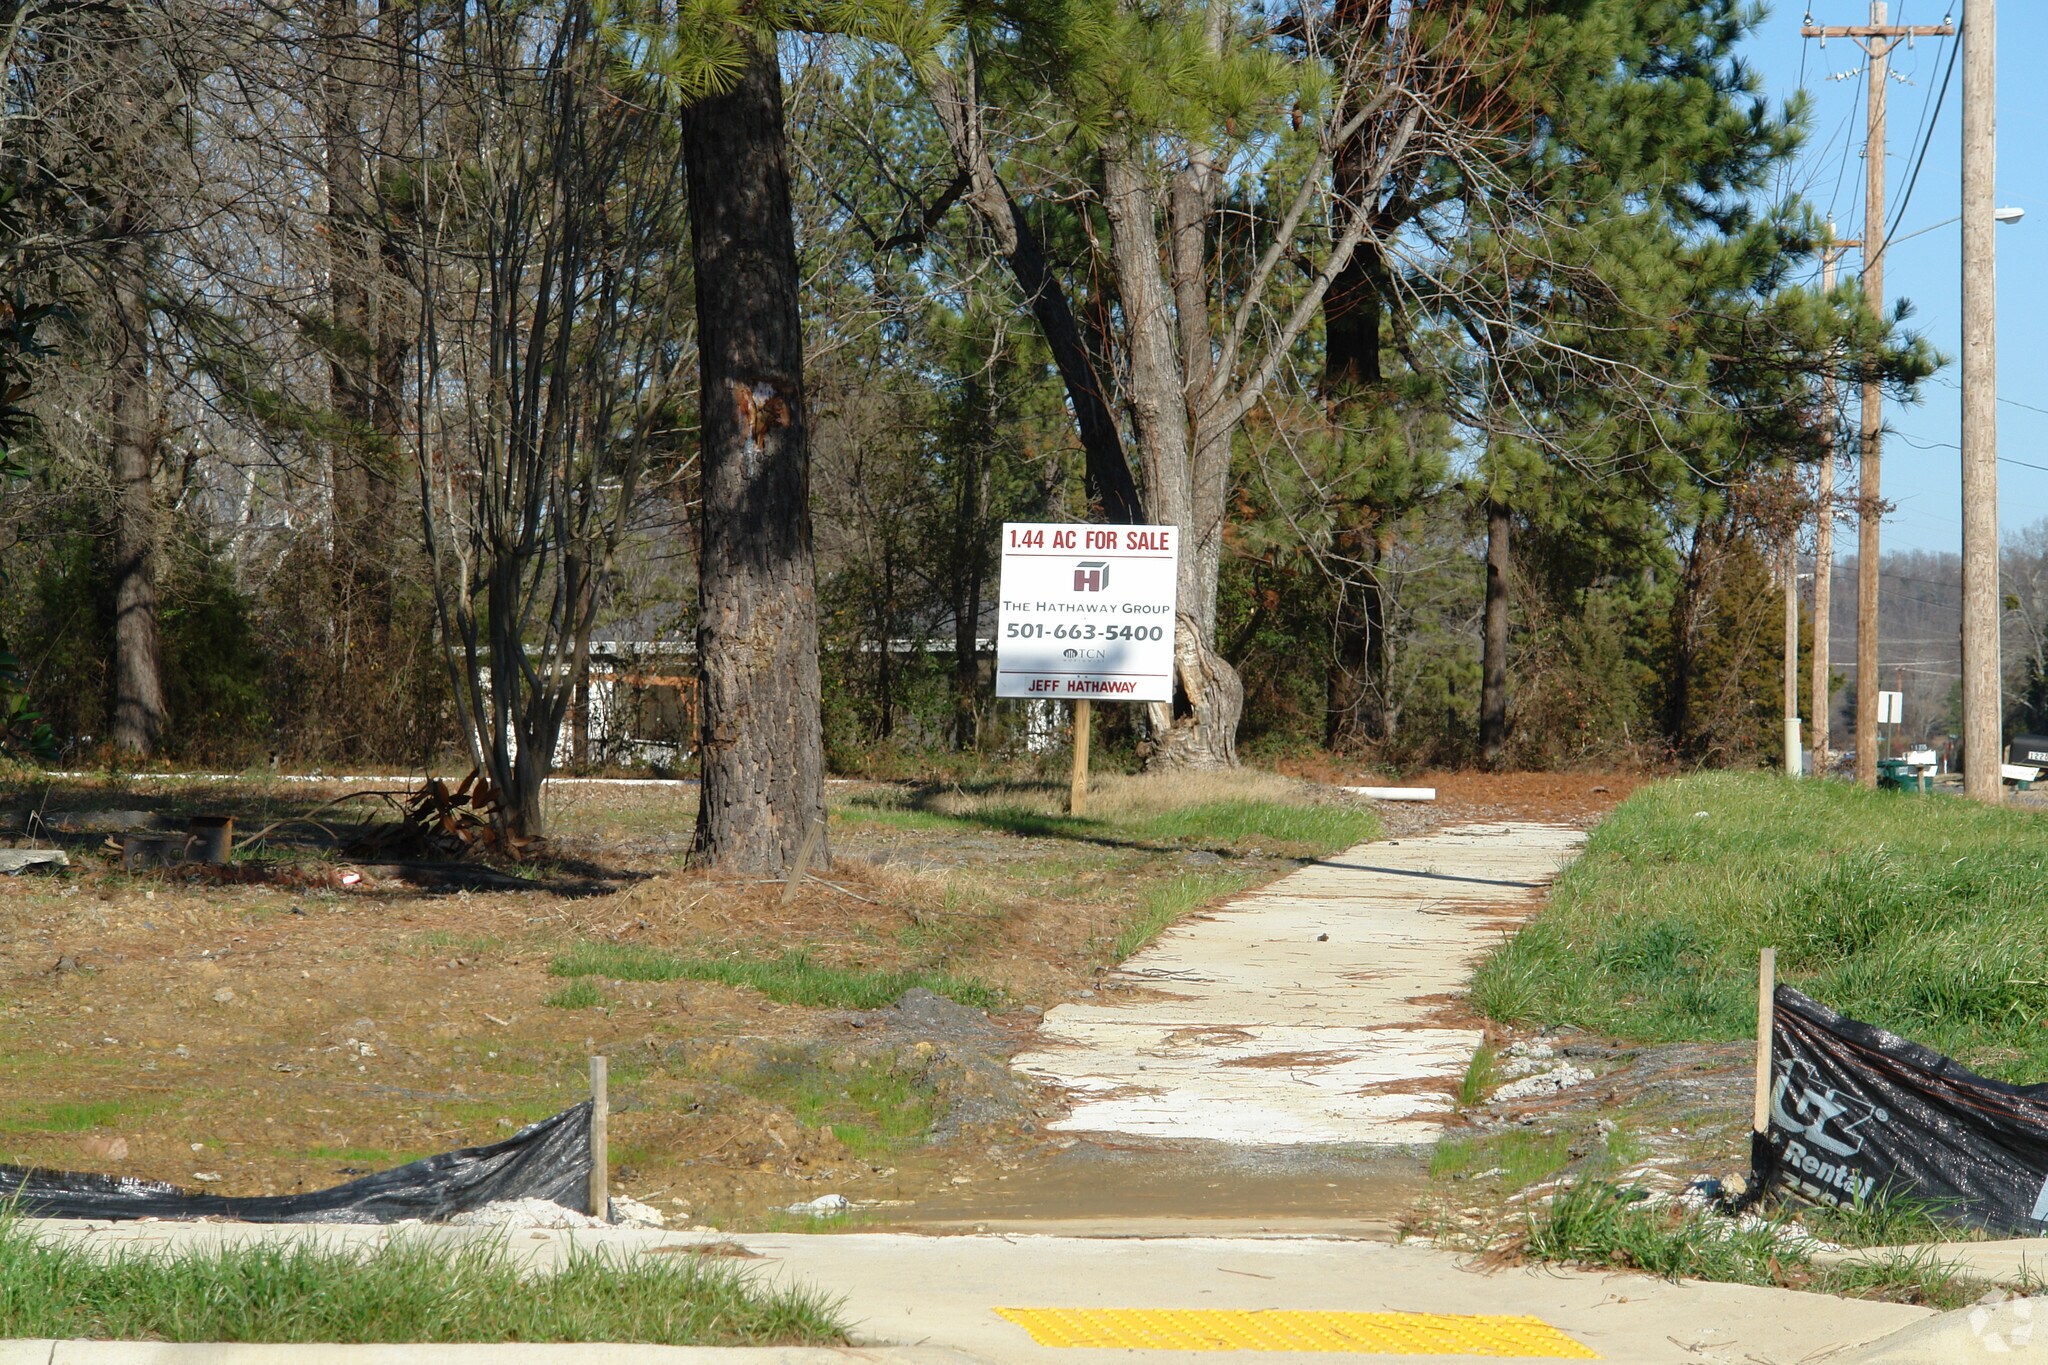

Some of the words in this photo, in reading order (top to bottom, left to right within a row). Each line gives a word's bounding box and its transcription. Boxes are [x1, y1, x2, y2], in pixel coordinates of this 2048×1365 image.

[1010, 529, 1045, 549] 1.44
[1052, 530, 1077, 549] AC
[1085, 530, 1118, 550] FOR
[1126, 531, 1170, 551] SALE
[1003, 600, 1030, 612] THE
[1036, 601, 1118, 614] HATHAWAY
[1122, 603, 1170, 615] GROUP
[1006, 622, 1163, 641] 501-663-5400
[1078, 648, 1106, 659] TCN
[1028, 679, 1061, 692] JEFF
[1067, 680, 1137, 693] HATHAWAY
[1782, 1139, 1876, 1199] Rental
